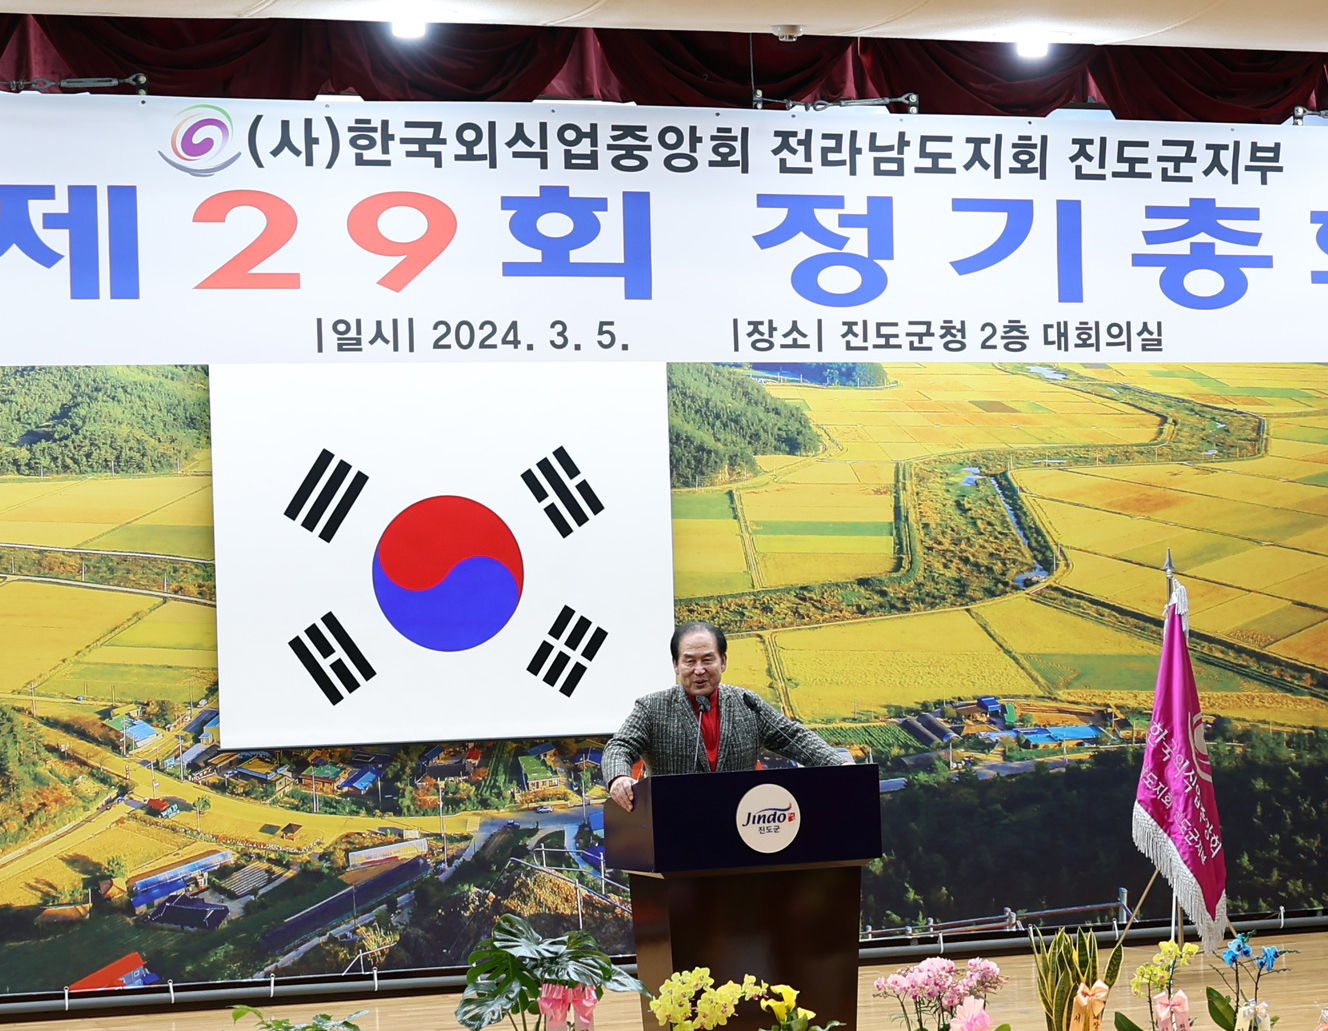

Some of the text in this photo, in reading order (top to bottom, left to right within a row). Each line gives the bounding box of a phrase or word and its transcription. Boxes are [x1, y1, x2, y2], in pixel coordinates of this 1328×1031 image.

[247, 113, 1285, 186] (사)한국외식업중앙회 전라남도지회 진도군지부
[839, 319, 968, 354] 진도군청
[980, 320, 1030, 354] 2층
[1042, 321, 1165, 354] 대회의실
[742, 811, 787, 827] Jindo
[758, 826, 780, 835] 진도군
